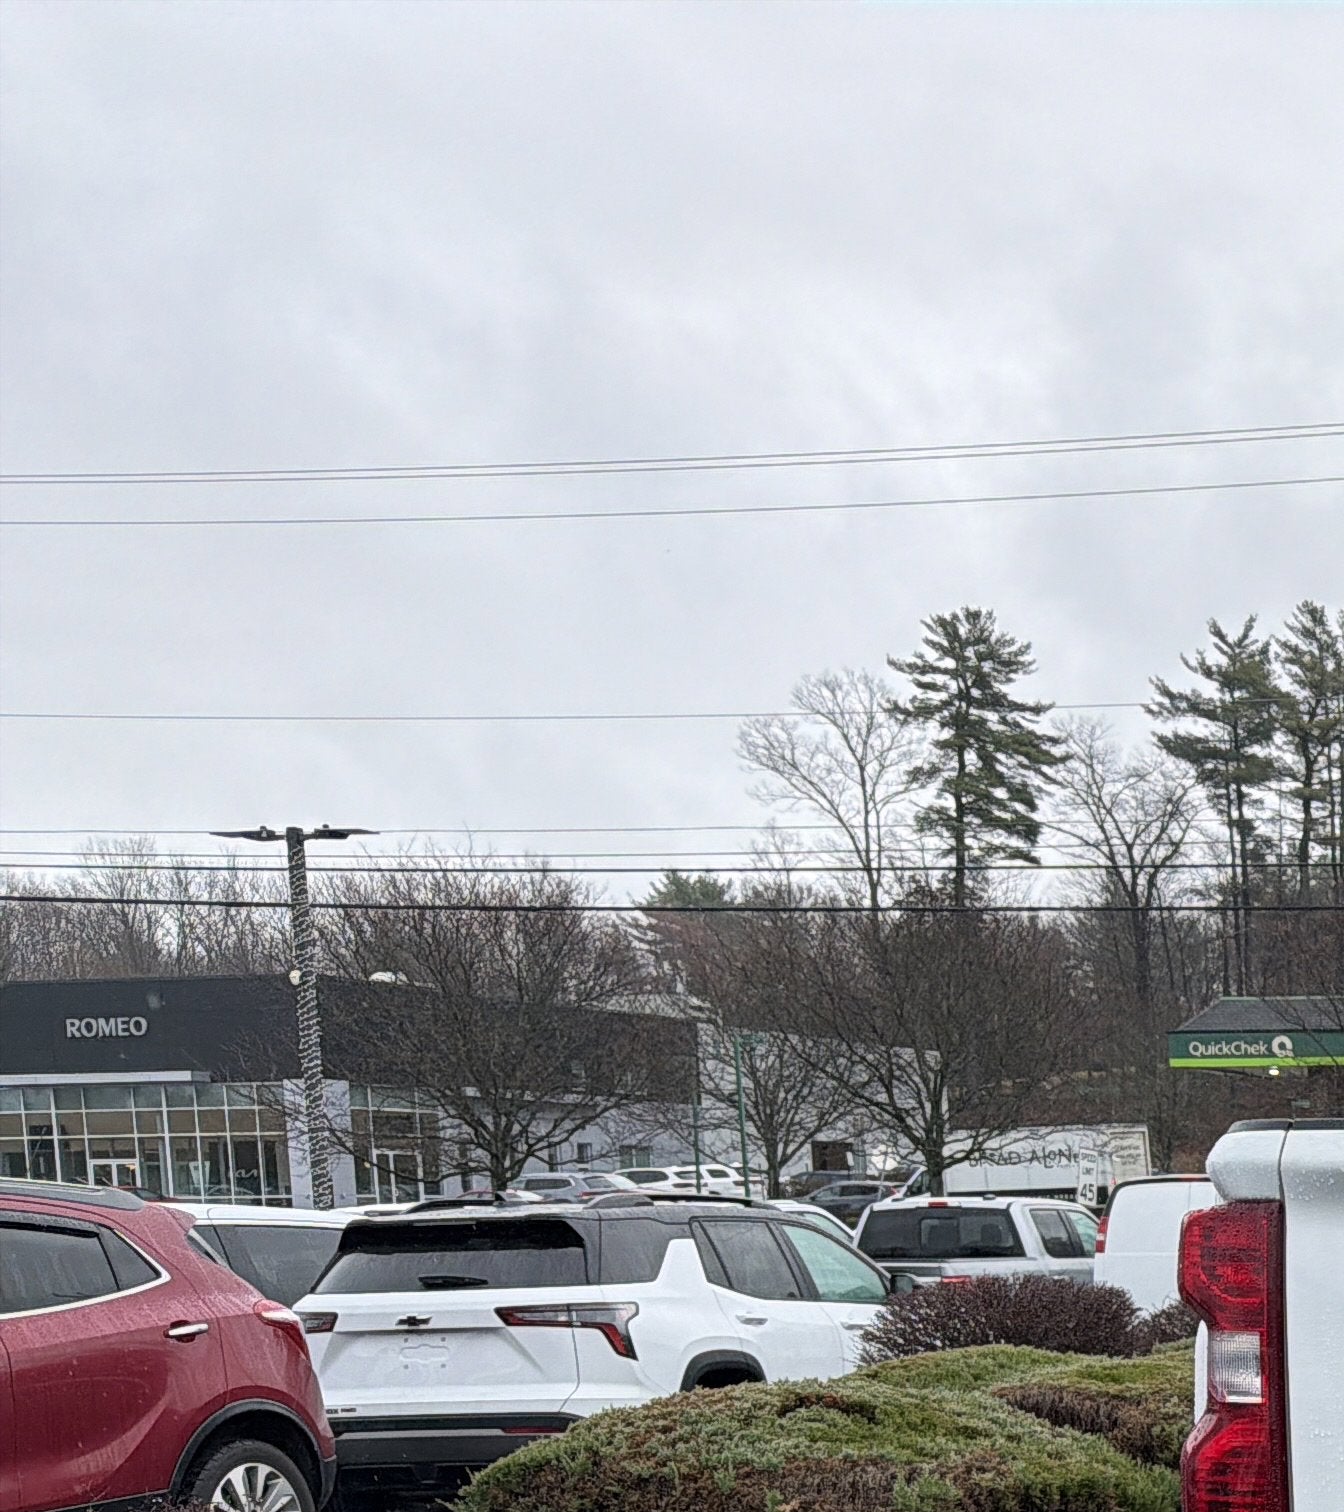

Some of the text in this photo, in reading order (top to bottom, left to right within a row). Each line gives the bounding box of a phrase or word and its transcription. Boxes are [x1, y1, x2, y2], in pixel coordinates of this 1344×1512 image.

[65, 1016, 148, 1038] ROMEO
[1188, 1040, 1269, 1057] QuickChek
[1080, 1183, 1095, 1202] 45
